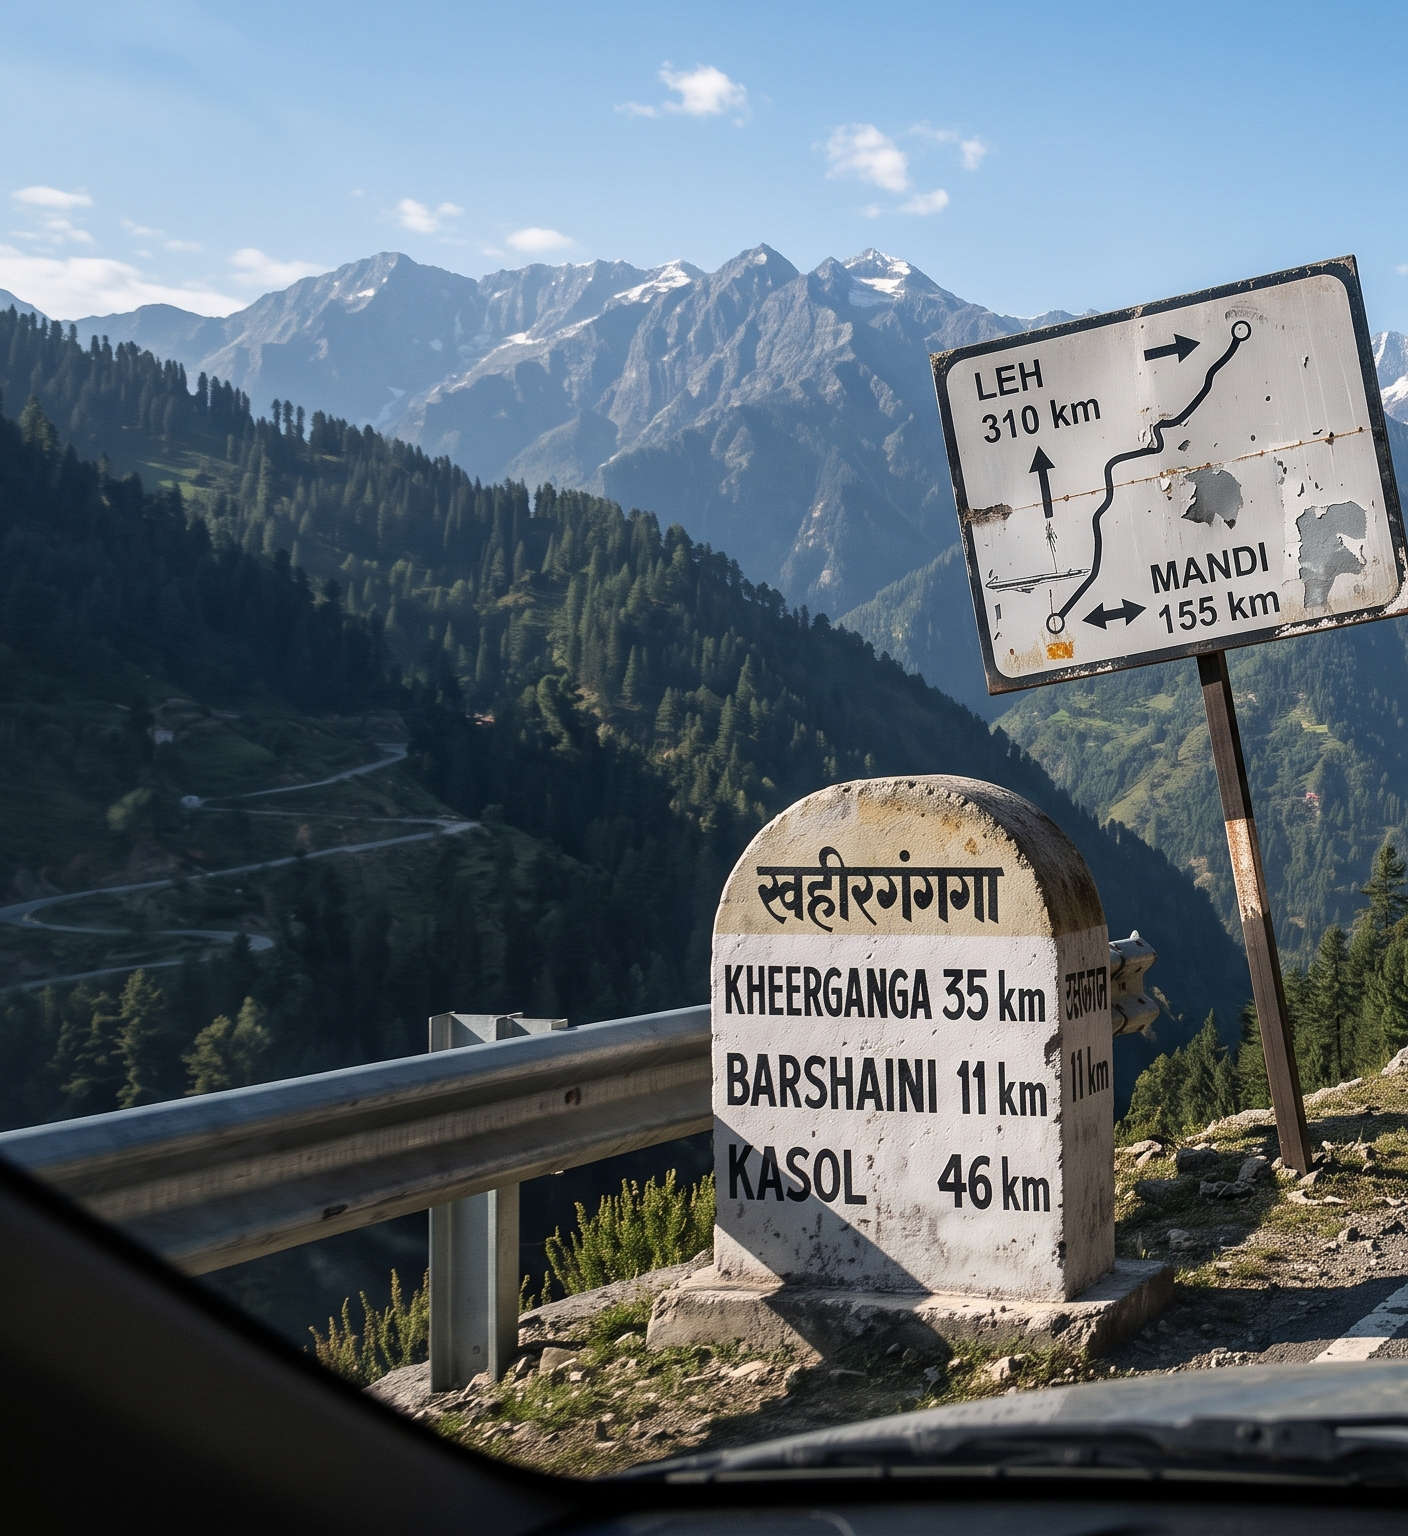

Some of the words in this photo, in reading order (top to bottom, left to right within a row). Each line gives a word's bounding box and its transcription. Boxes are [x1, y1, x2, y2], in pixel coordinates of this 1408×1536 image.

[975, 359, 1043, 400] LEH
[982, 405, 1039, 443] 310
[1050, 399, 1100, 428] km
[1151, 542, 1268, 593] MANDI
[1159, 596, 1217, 633] 155
[1228, 592, 1280, 621] km
[725, 964, 932, 1019] KHEERGANGA
[943, 969, 988, 1020] 35
[999, 970, 1045, 1022] km
[727, 1053, 937, 1113] BARSHAINI
[957, 1061, 986, 1114] 11
[999, 1062, 1046, 1116] km
[1071, 1049, 1083, 1103] 11
[1088, 1047, 1108, 1096] km
[729, 1143, 867, 1206] KASOL
[938, 1154, 992, 1209] 46
[1002, 1156, 1050, 1212] km
